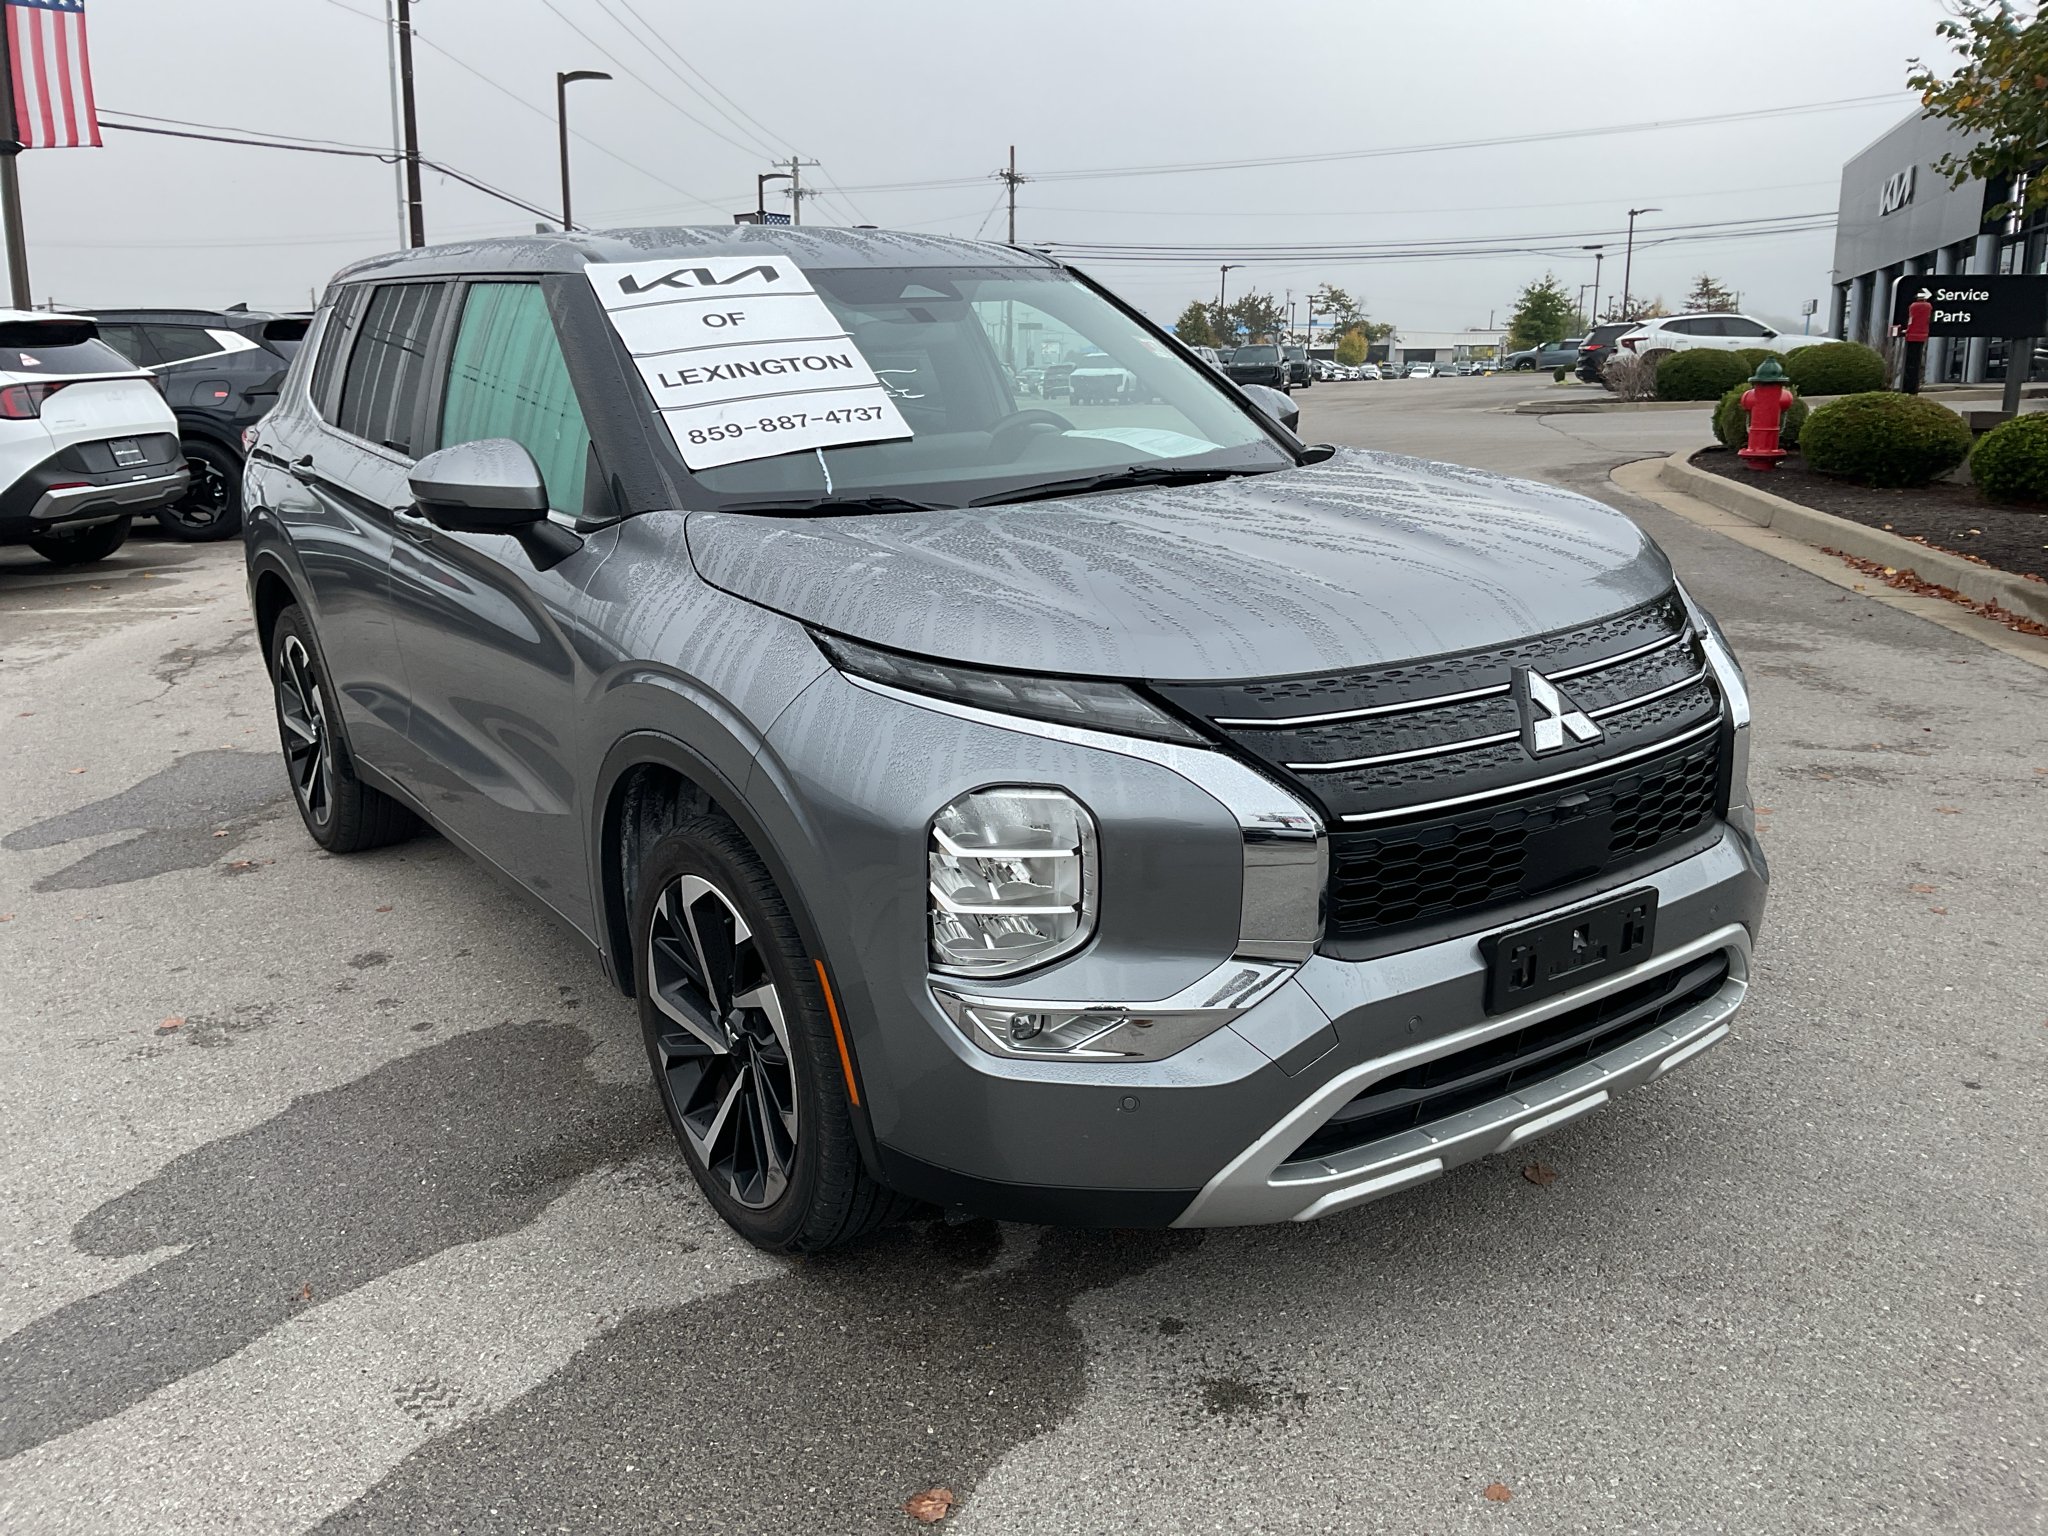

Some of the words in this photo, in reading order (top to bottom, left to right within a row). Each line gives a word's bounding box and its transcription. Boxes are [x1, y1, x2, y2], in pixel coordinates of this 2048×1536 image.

[1879, 165, 1916, 216] KIA
[618, 265, 780, 294] KIA
[1937, 288, 1989, 301] Service
[702, 312, 747, 329] OF
[1934, 310, 1972, 322] Parts
[657, 354, 853, 389] LEXINGTON
[688, 406, 883, 444] 859-887-4737
